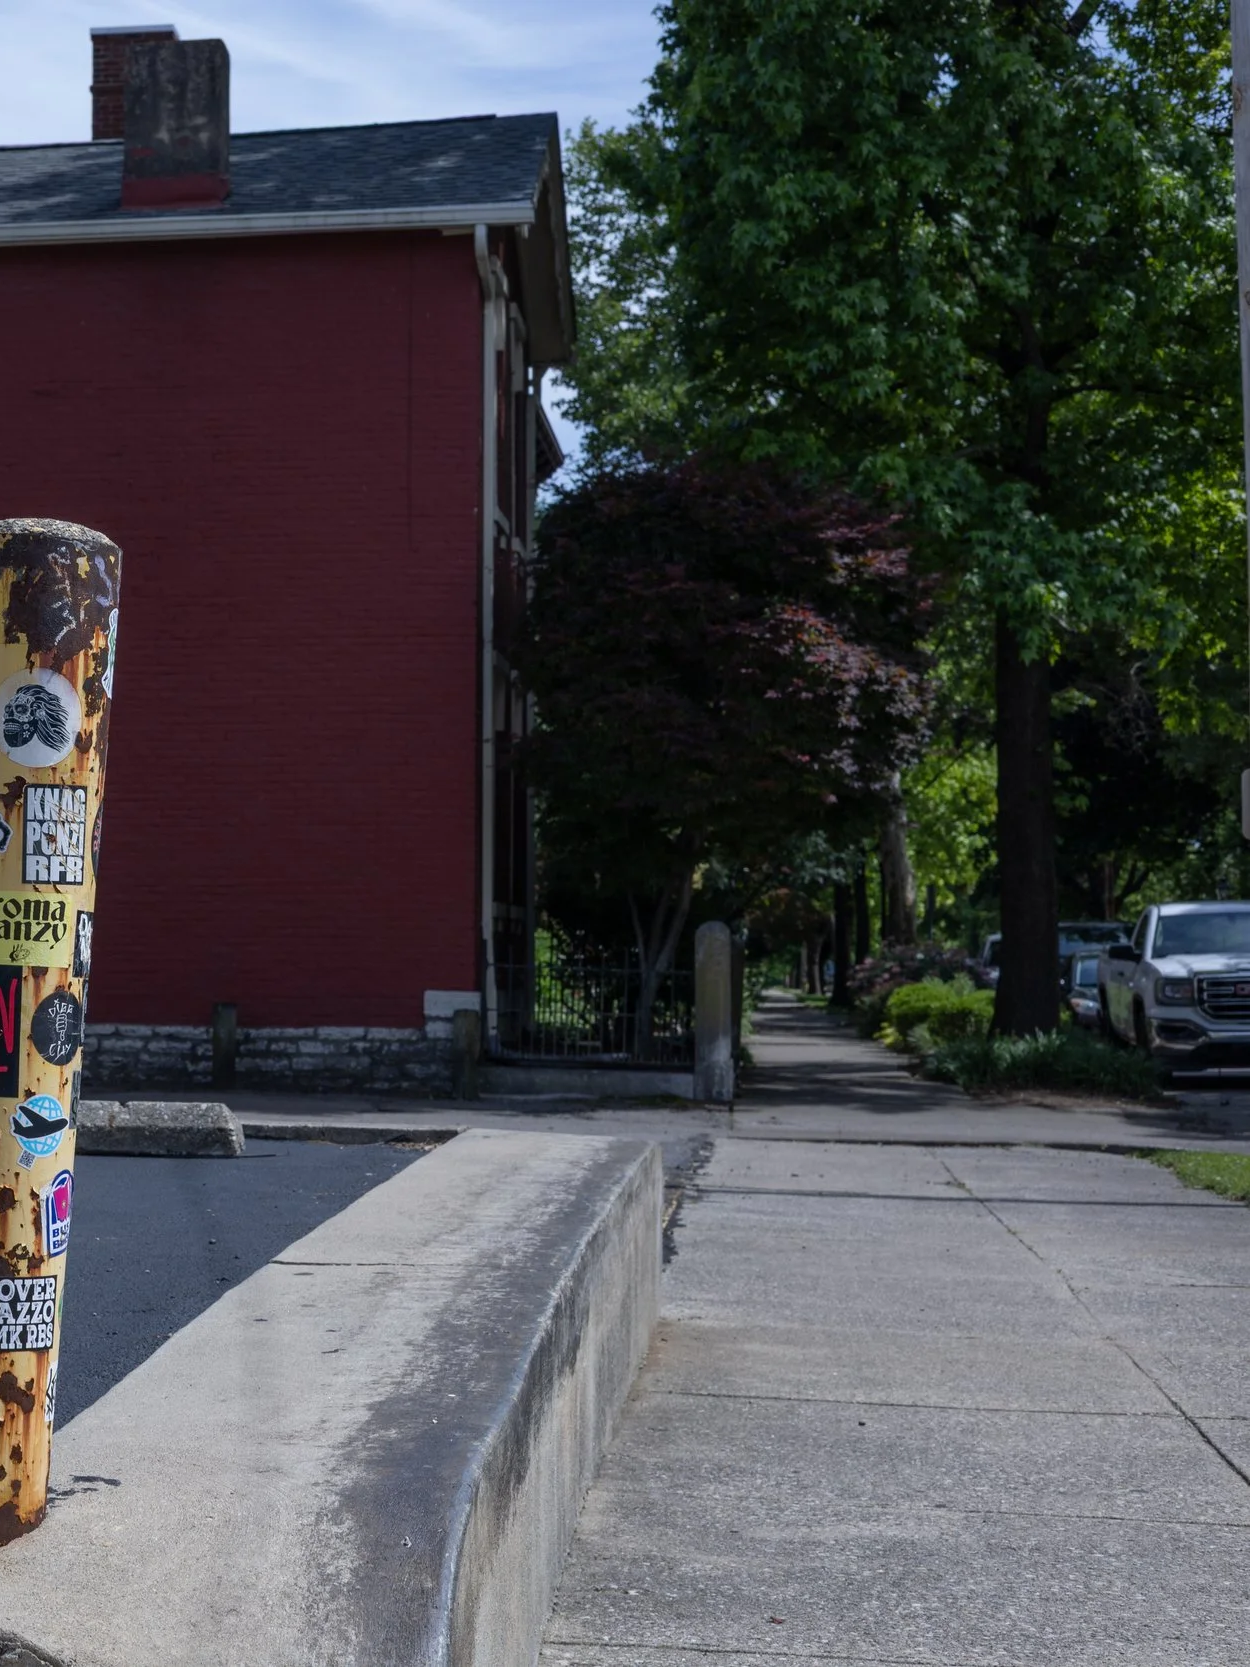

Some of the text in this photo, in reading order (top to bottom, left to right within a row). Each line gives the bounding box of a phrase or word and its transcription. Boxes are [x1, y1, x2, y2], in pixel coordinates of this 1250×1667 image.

[26, 821, 85, 856] PONZI
[26, 855, 83, 882] RFR
[25, 1323, 53, 1349] RBS
